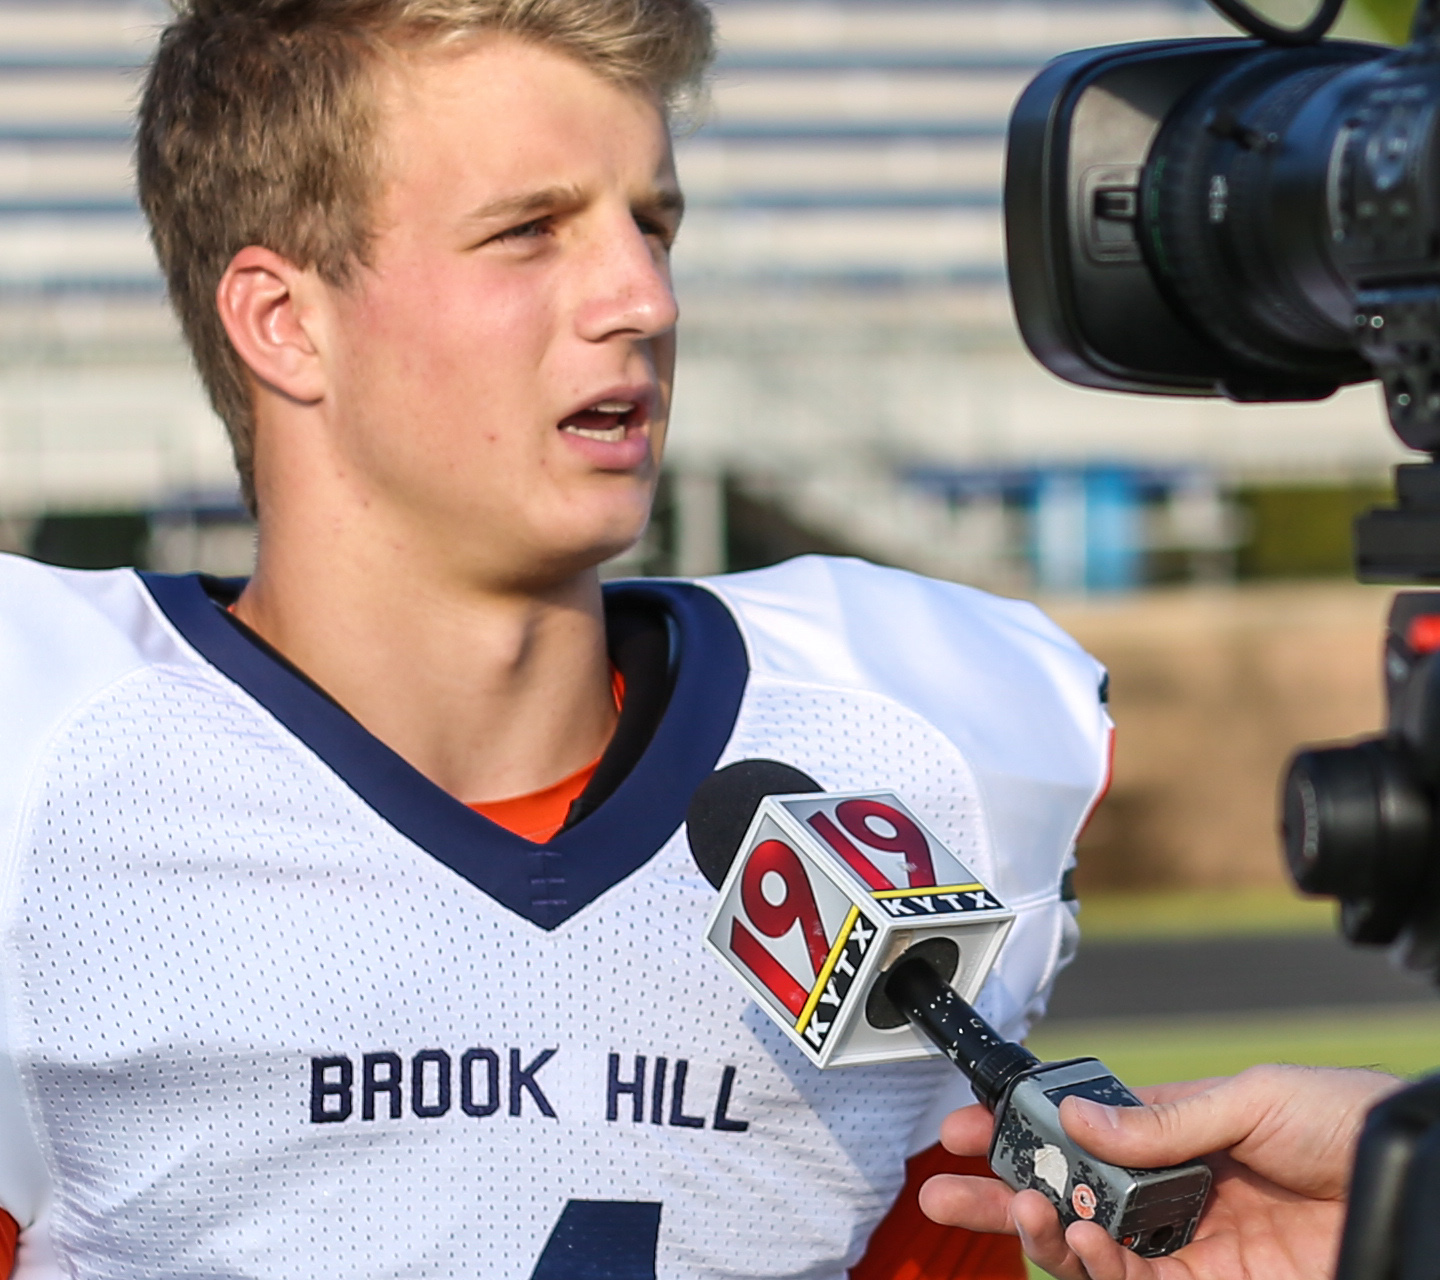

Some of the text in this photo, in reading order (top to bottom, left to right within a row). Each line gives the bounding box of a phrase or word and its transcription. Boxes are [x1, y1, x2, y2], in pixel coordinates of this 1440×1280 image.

[806, 799, 937, 891] 19
[730, 839, 831, 1019] 19
[879, 892, 998, 916] KYTX
[804, 918, 873, 1048] KYTX
[309, 1045, 749, 1132] BROOK HILL
